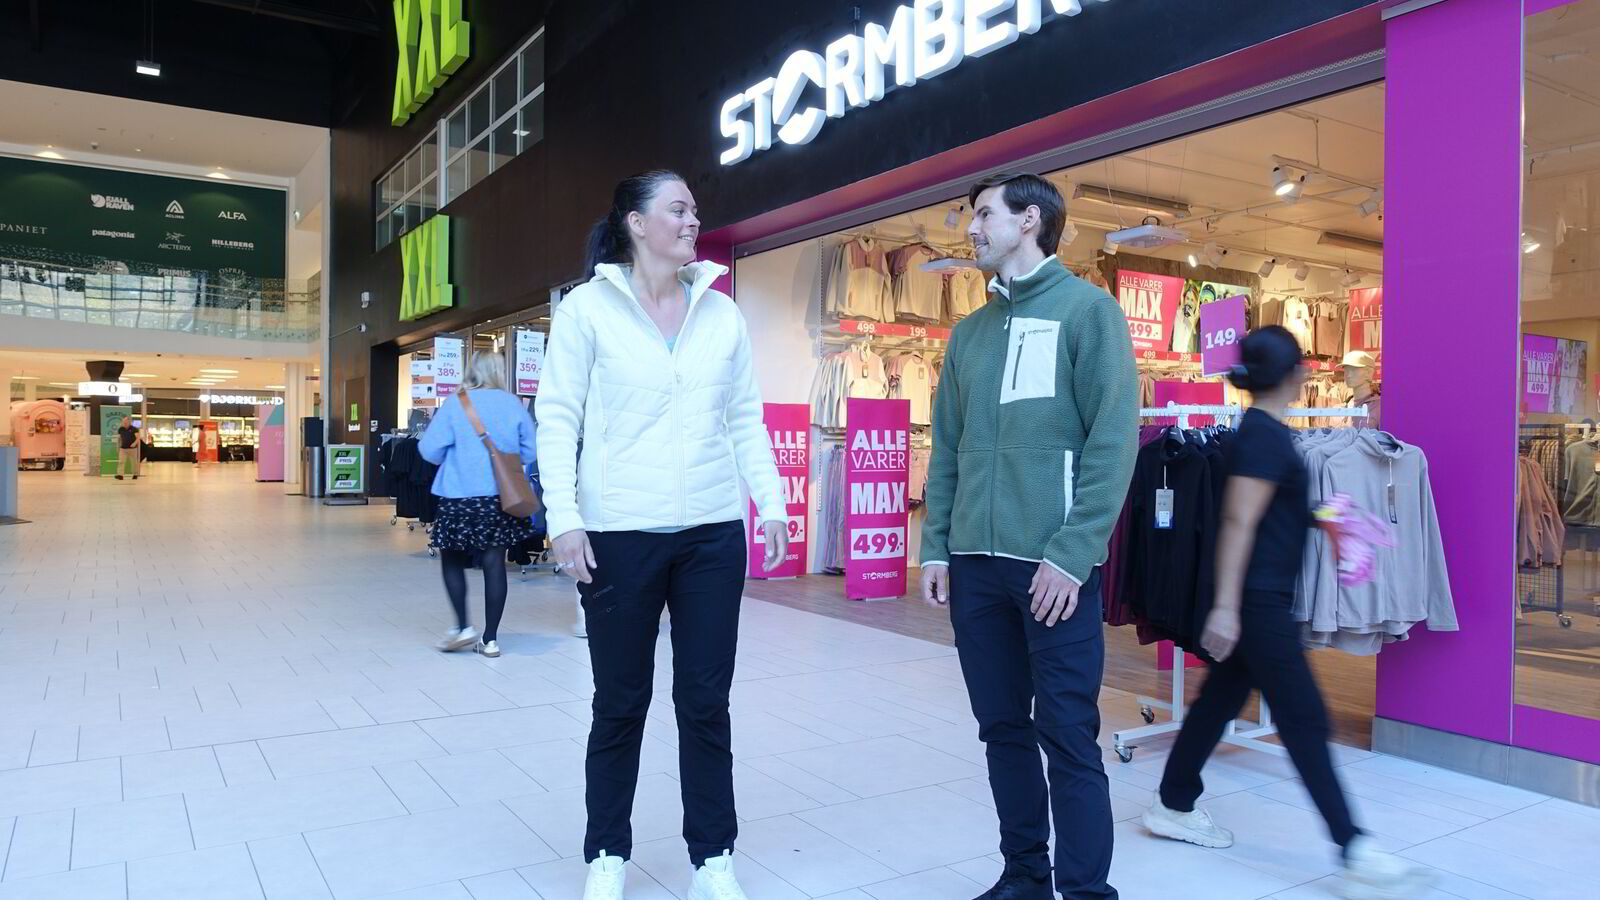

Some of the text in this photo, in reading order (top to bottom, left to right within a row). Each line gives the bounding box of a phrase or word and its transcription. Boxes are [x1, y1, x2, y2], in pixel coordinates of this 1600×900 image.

[392, 0, 470, 127] XXL
[217, 211, 247, 221] ALFA
[92, 229, 135, 239] patagonia
[211, 239, 254, 248] HILLEBERG
[157, 267, 192, 278] PRIMUS
[399, 213, 453, 322] XXL
[1120, 274, 1163, 291] ALLE VARER
[1119, 286, 1163, 322] MAX
[851, 429, 906, 451] ALLE
[851, 451, 906, 470] VARER
[779, 475, 806, 505] AX
[851, 481, 905, 515] MAX
[862, 570, 898, 580] STORMBERG
